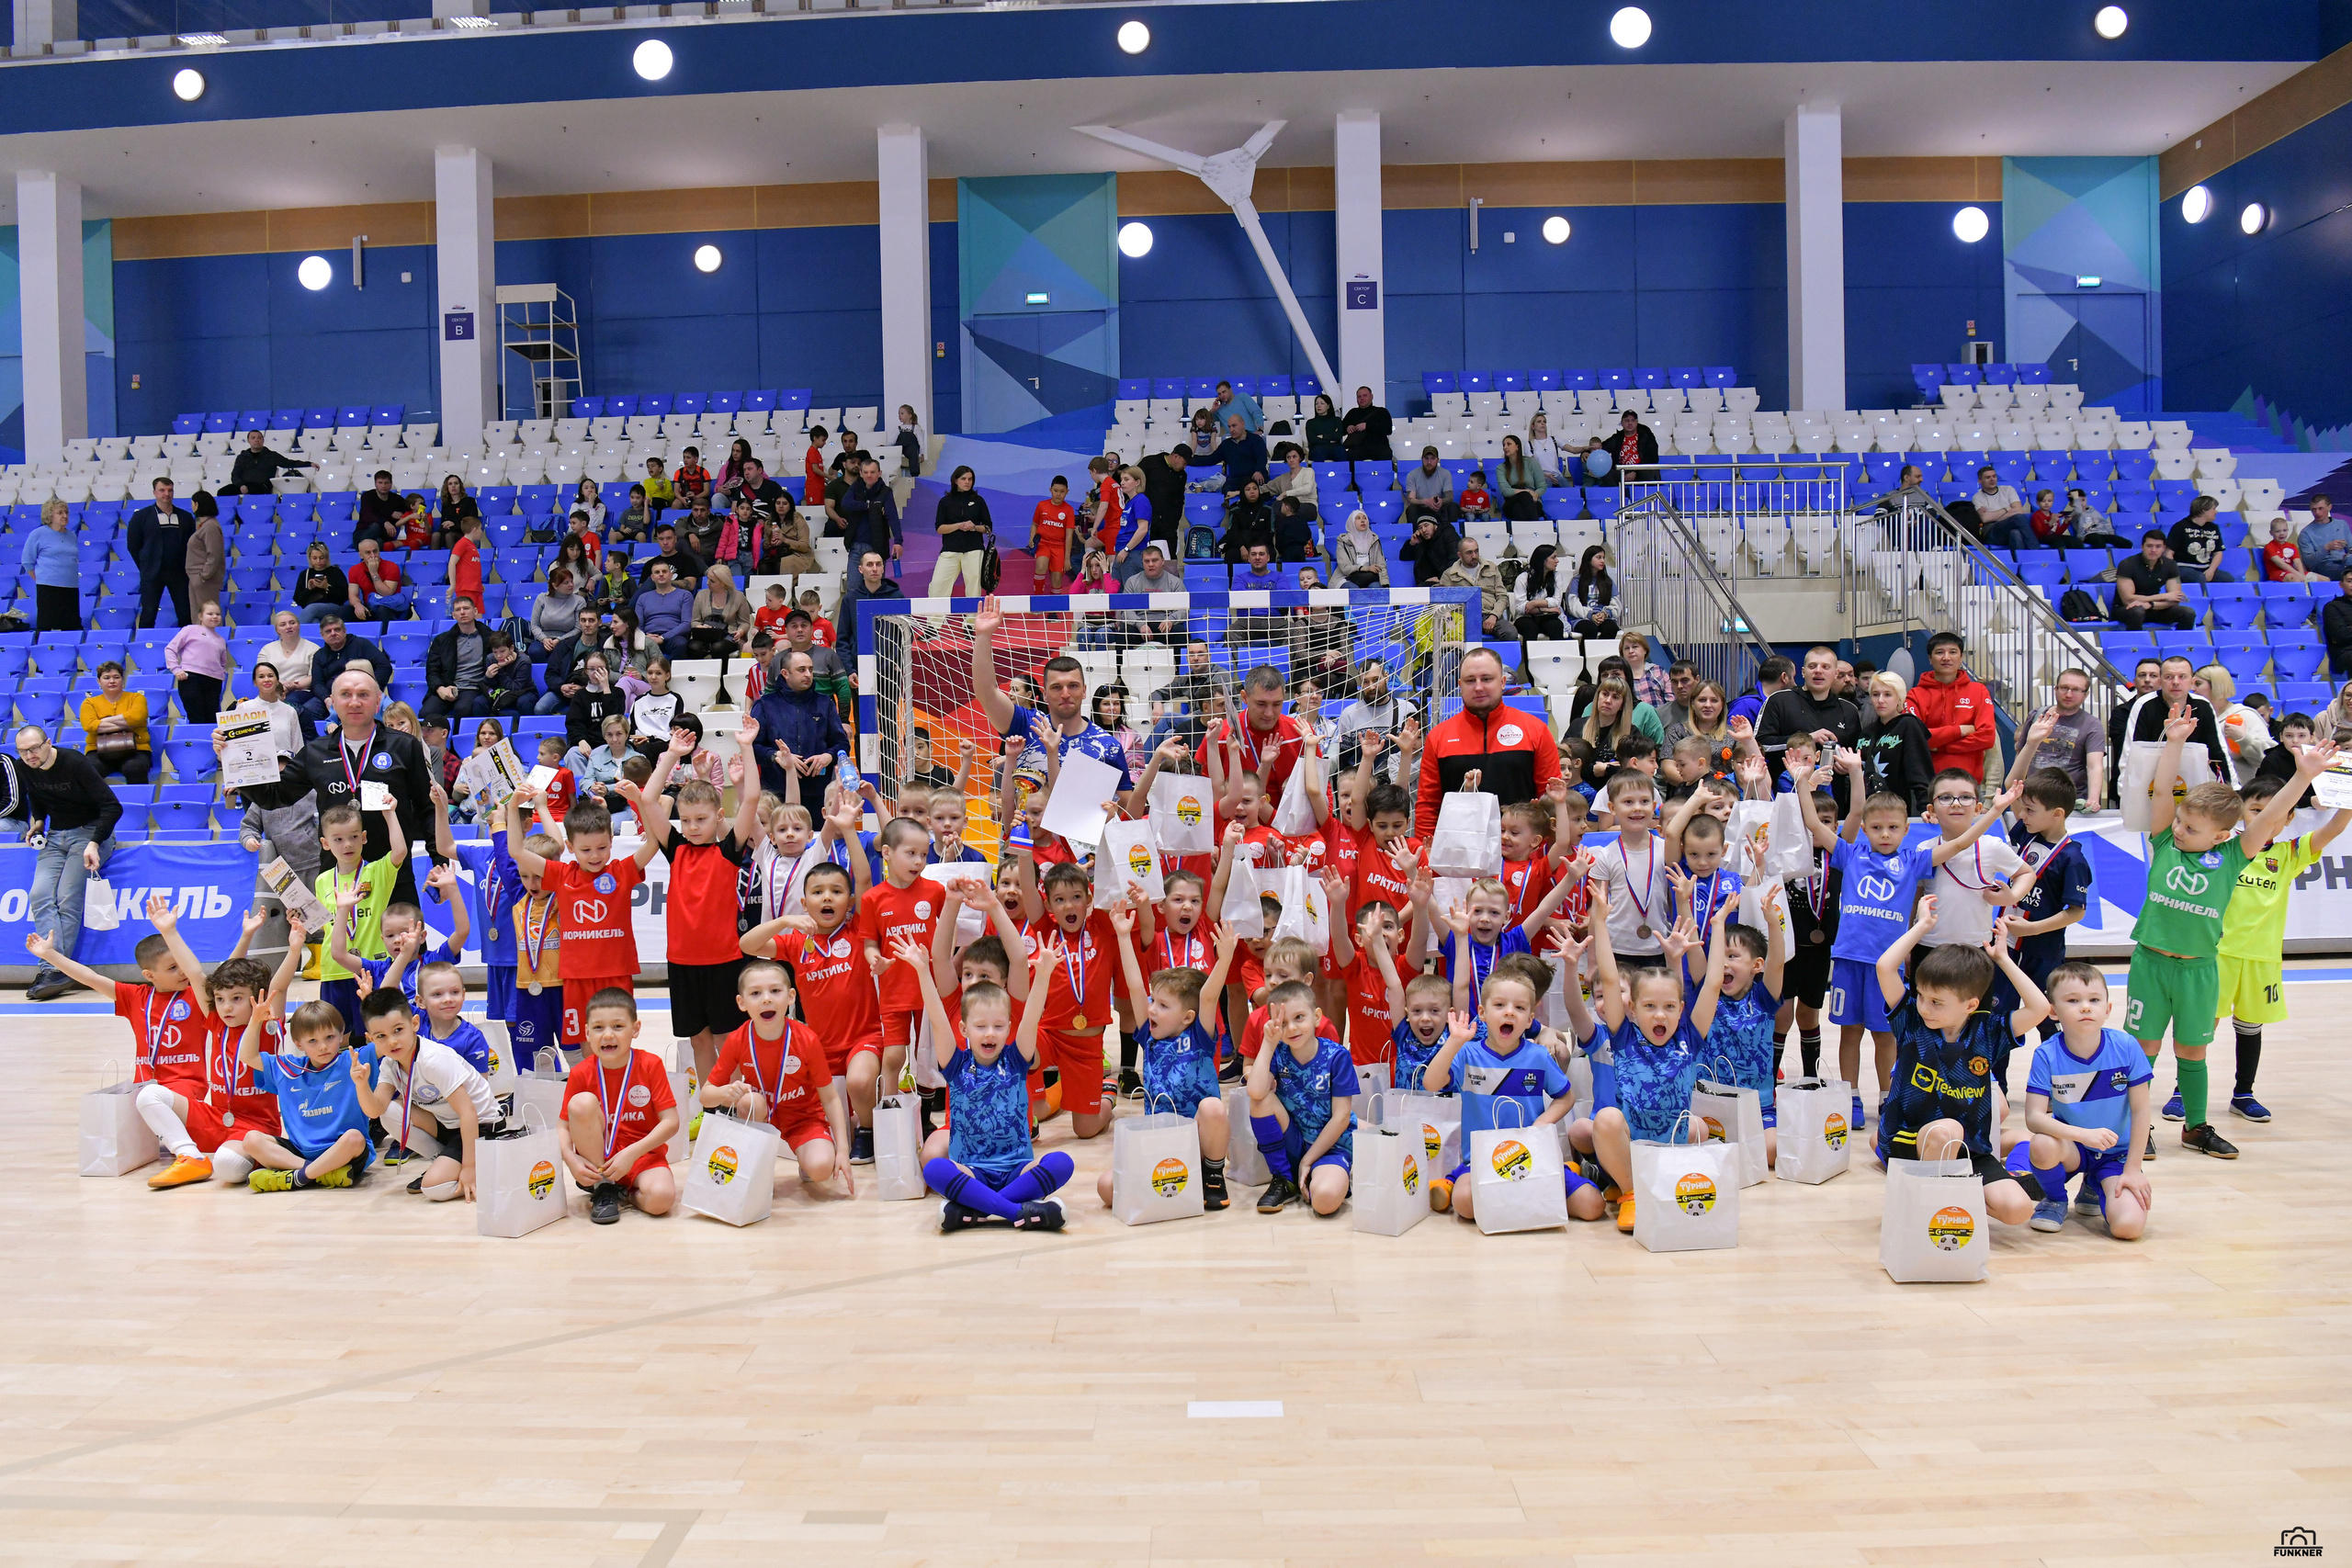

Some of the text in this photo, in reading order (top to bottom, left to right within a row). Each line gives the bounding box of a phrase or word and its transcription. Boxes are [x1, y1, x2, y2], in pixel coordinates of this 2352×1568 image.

[219, 710, 266, 725] ДИПЛОМ
[245, 750, 253, 761] 2
[2238, 874, 2277, 891] kuten
[1842, 905, 1904, 922] НОРНИКЕЛЬ
[562, 928, 625, 941] НОРНИКЕЛЬ
[886, 922, 927, 937] АРКТИКА
[806, 961, 853, 982] АРКТИКА
[2263, 983, 2278, 1004] 10
[565, 1008, 580, 1036] 3
[1176, 1036, 1191, 1054] 19
[716, 1150, 737, 1165] ТУРНИР
[1494, 1144, 1521, 1164] ТУРНИР
[1157, 1165, 1184, 1177] ТУРНИР
[1680, 1180, 1712, 1192] ТУРНИР
[1936, 1216, 1971, 1226] ТУРНИР
